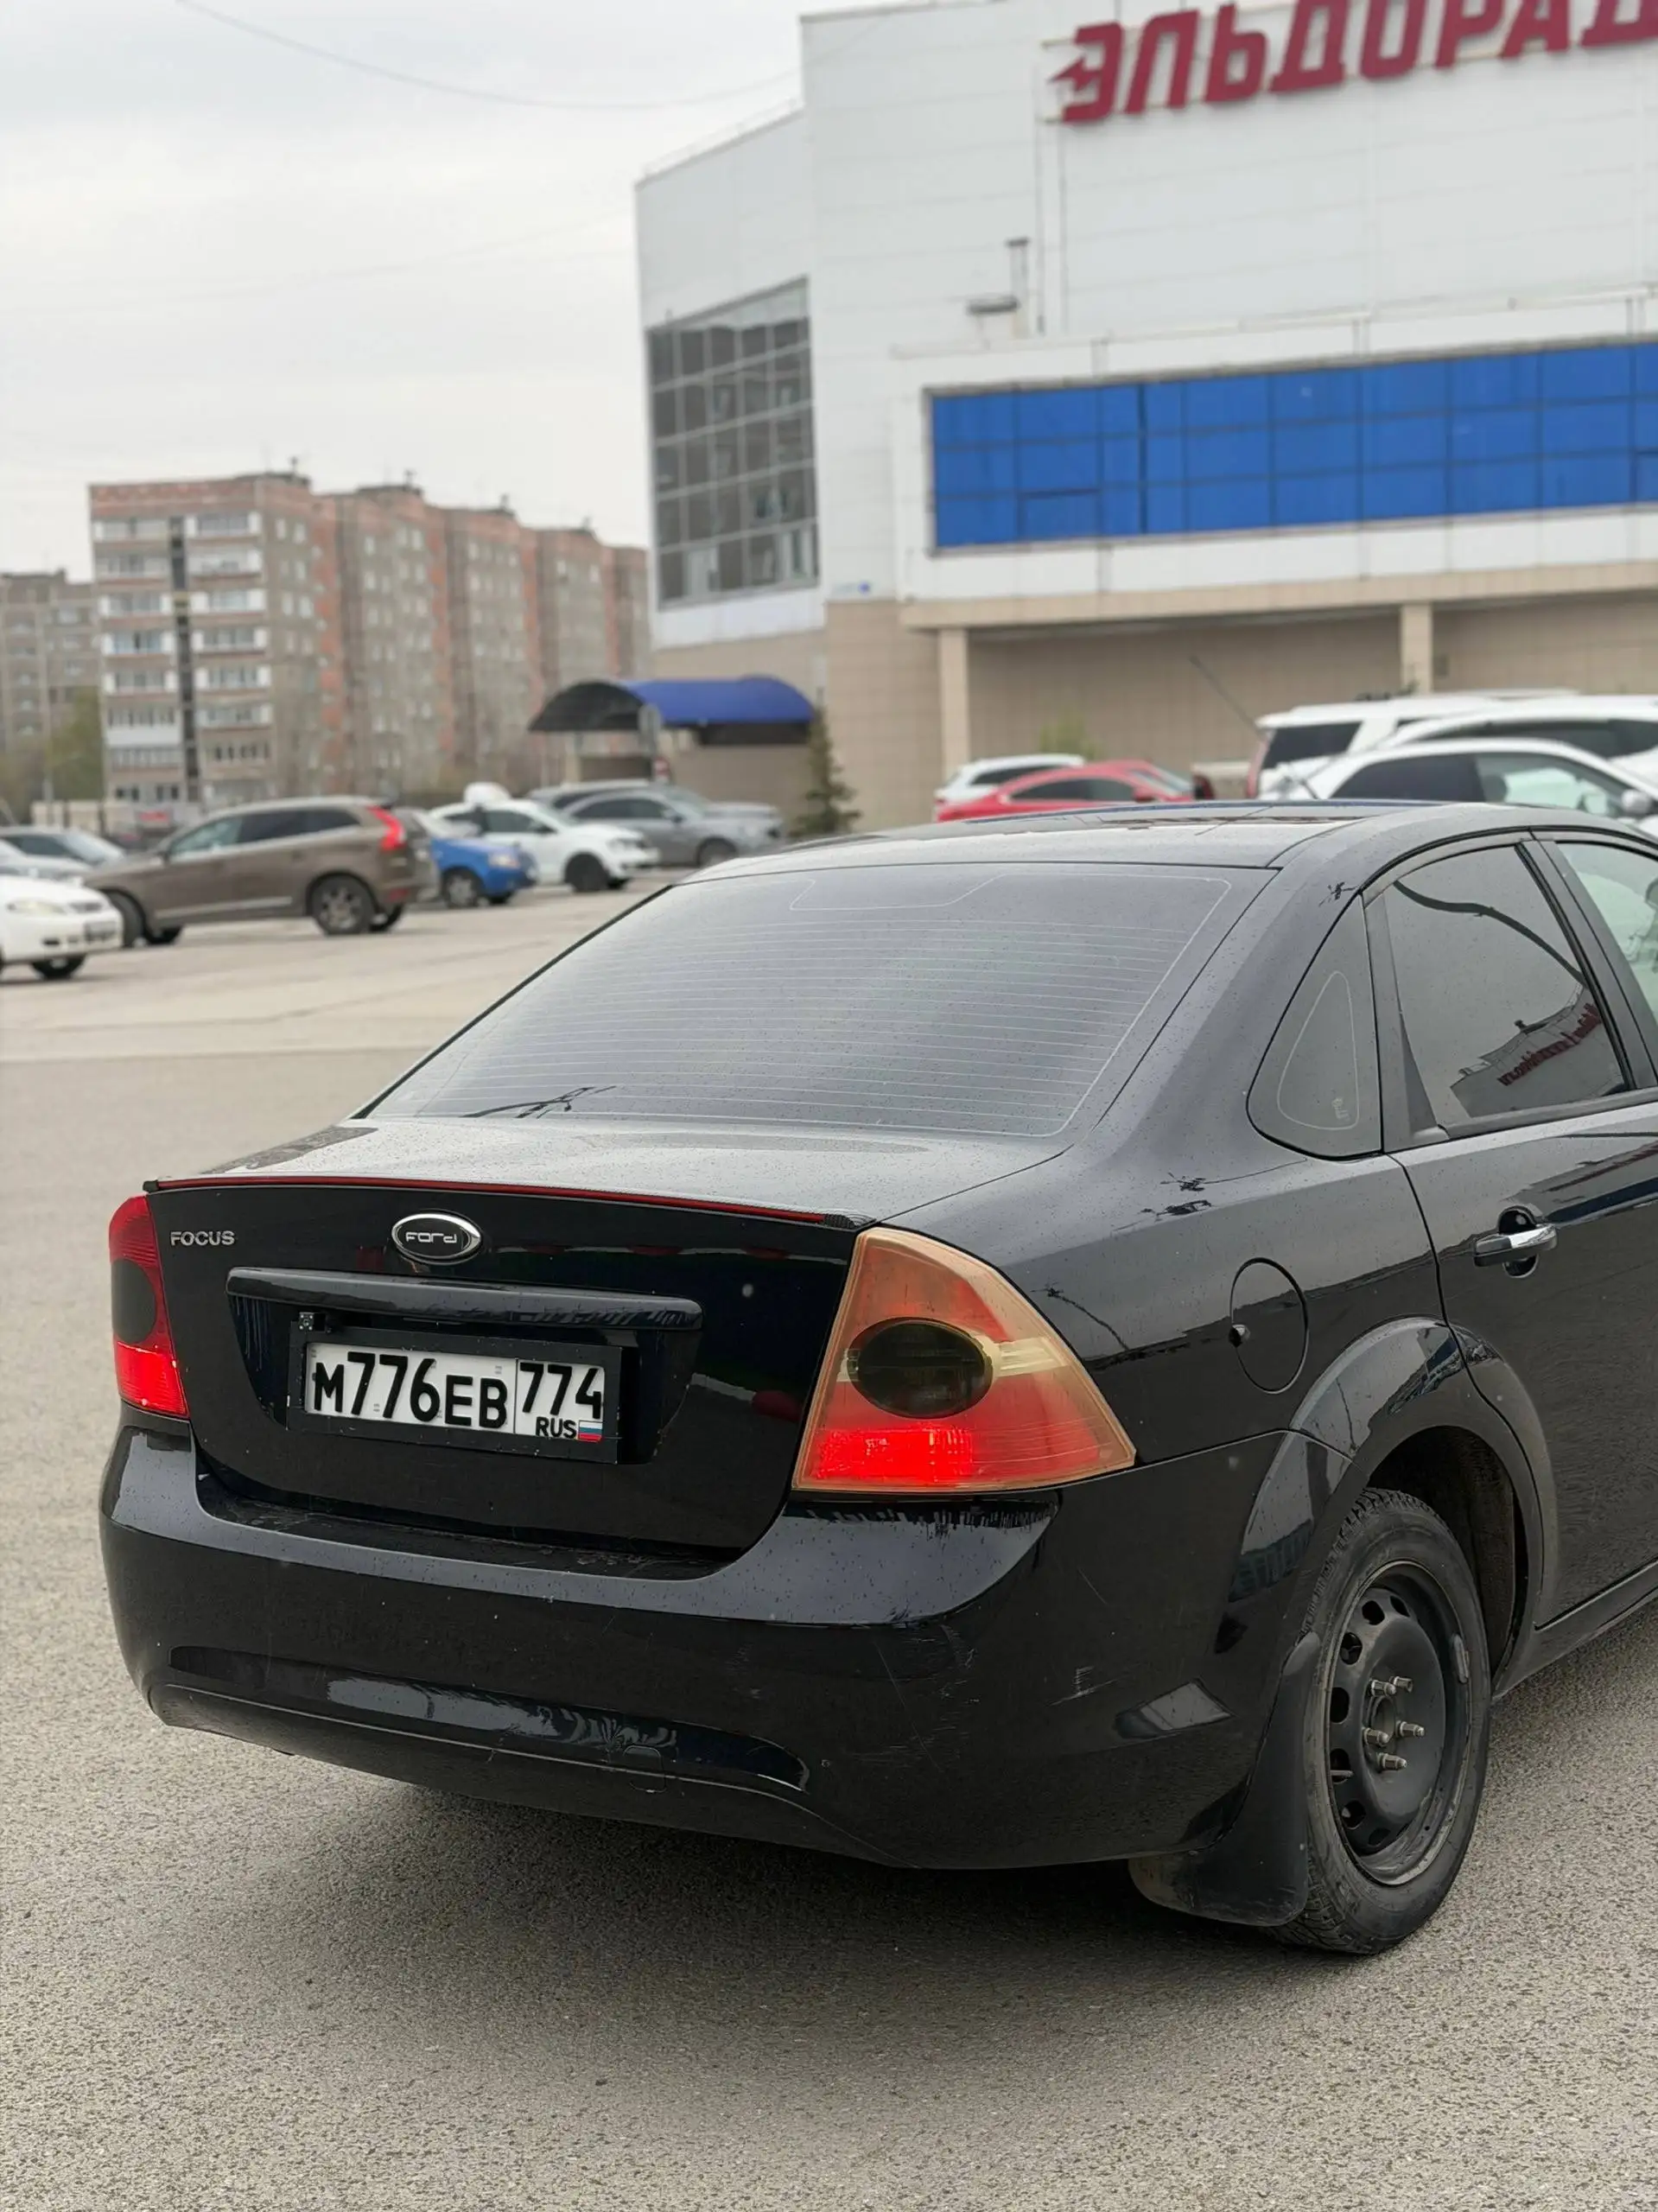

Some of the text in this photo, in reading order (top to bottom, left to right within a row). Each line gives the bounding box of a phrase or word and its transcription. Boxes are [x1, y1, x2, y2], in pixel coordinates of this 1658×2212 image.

[170, 1230, 235, 1247] FOCUS
[314, 1351, 603, 1429] М776ЕВ 774
[536, 1416, 577, 1440] RUS
